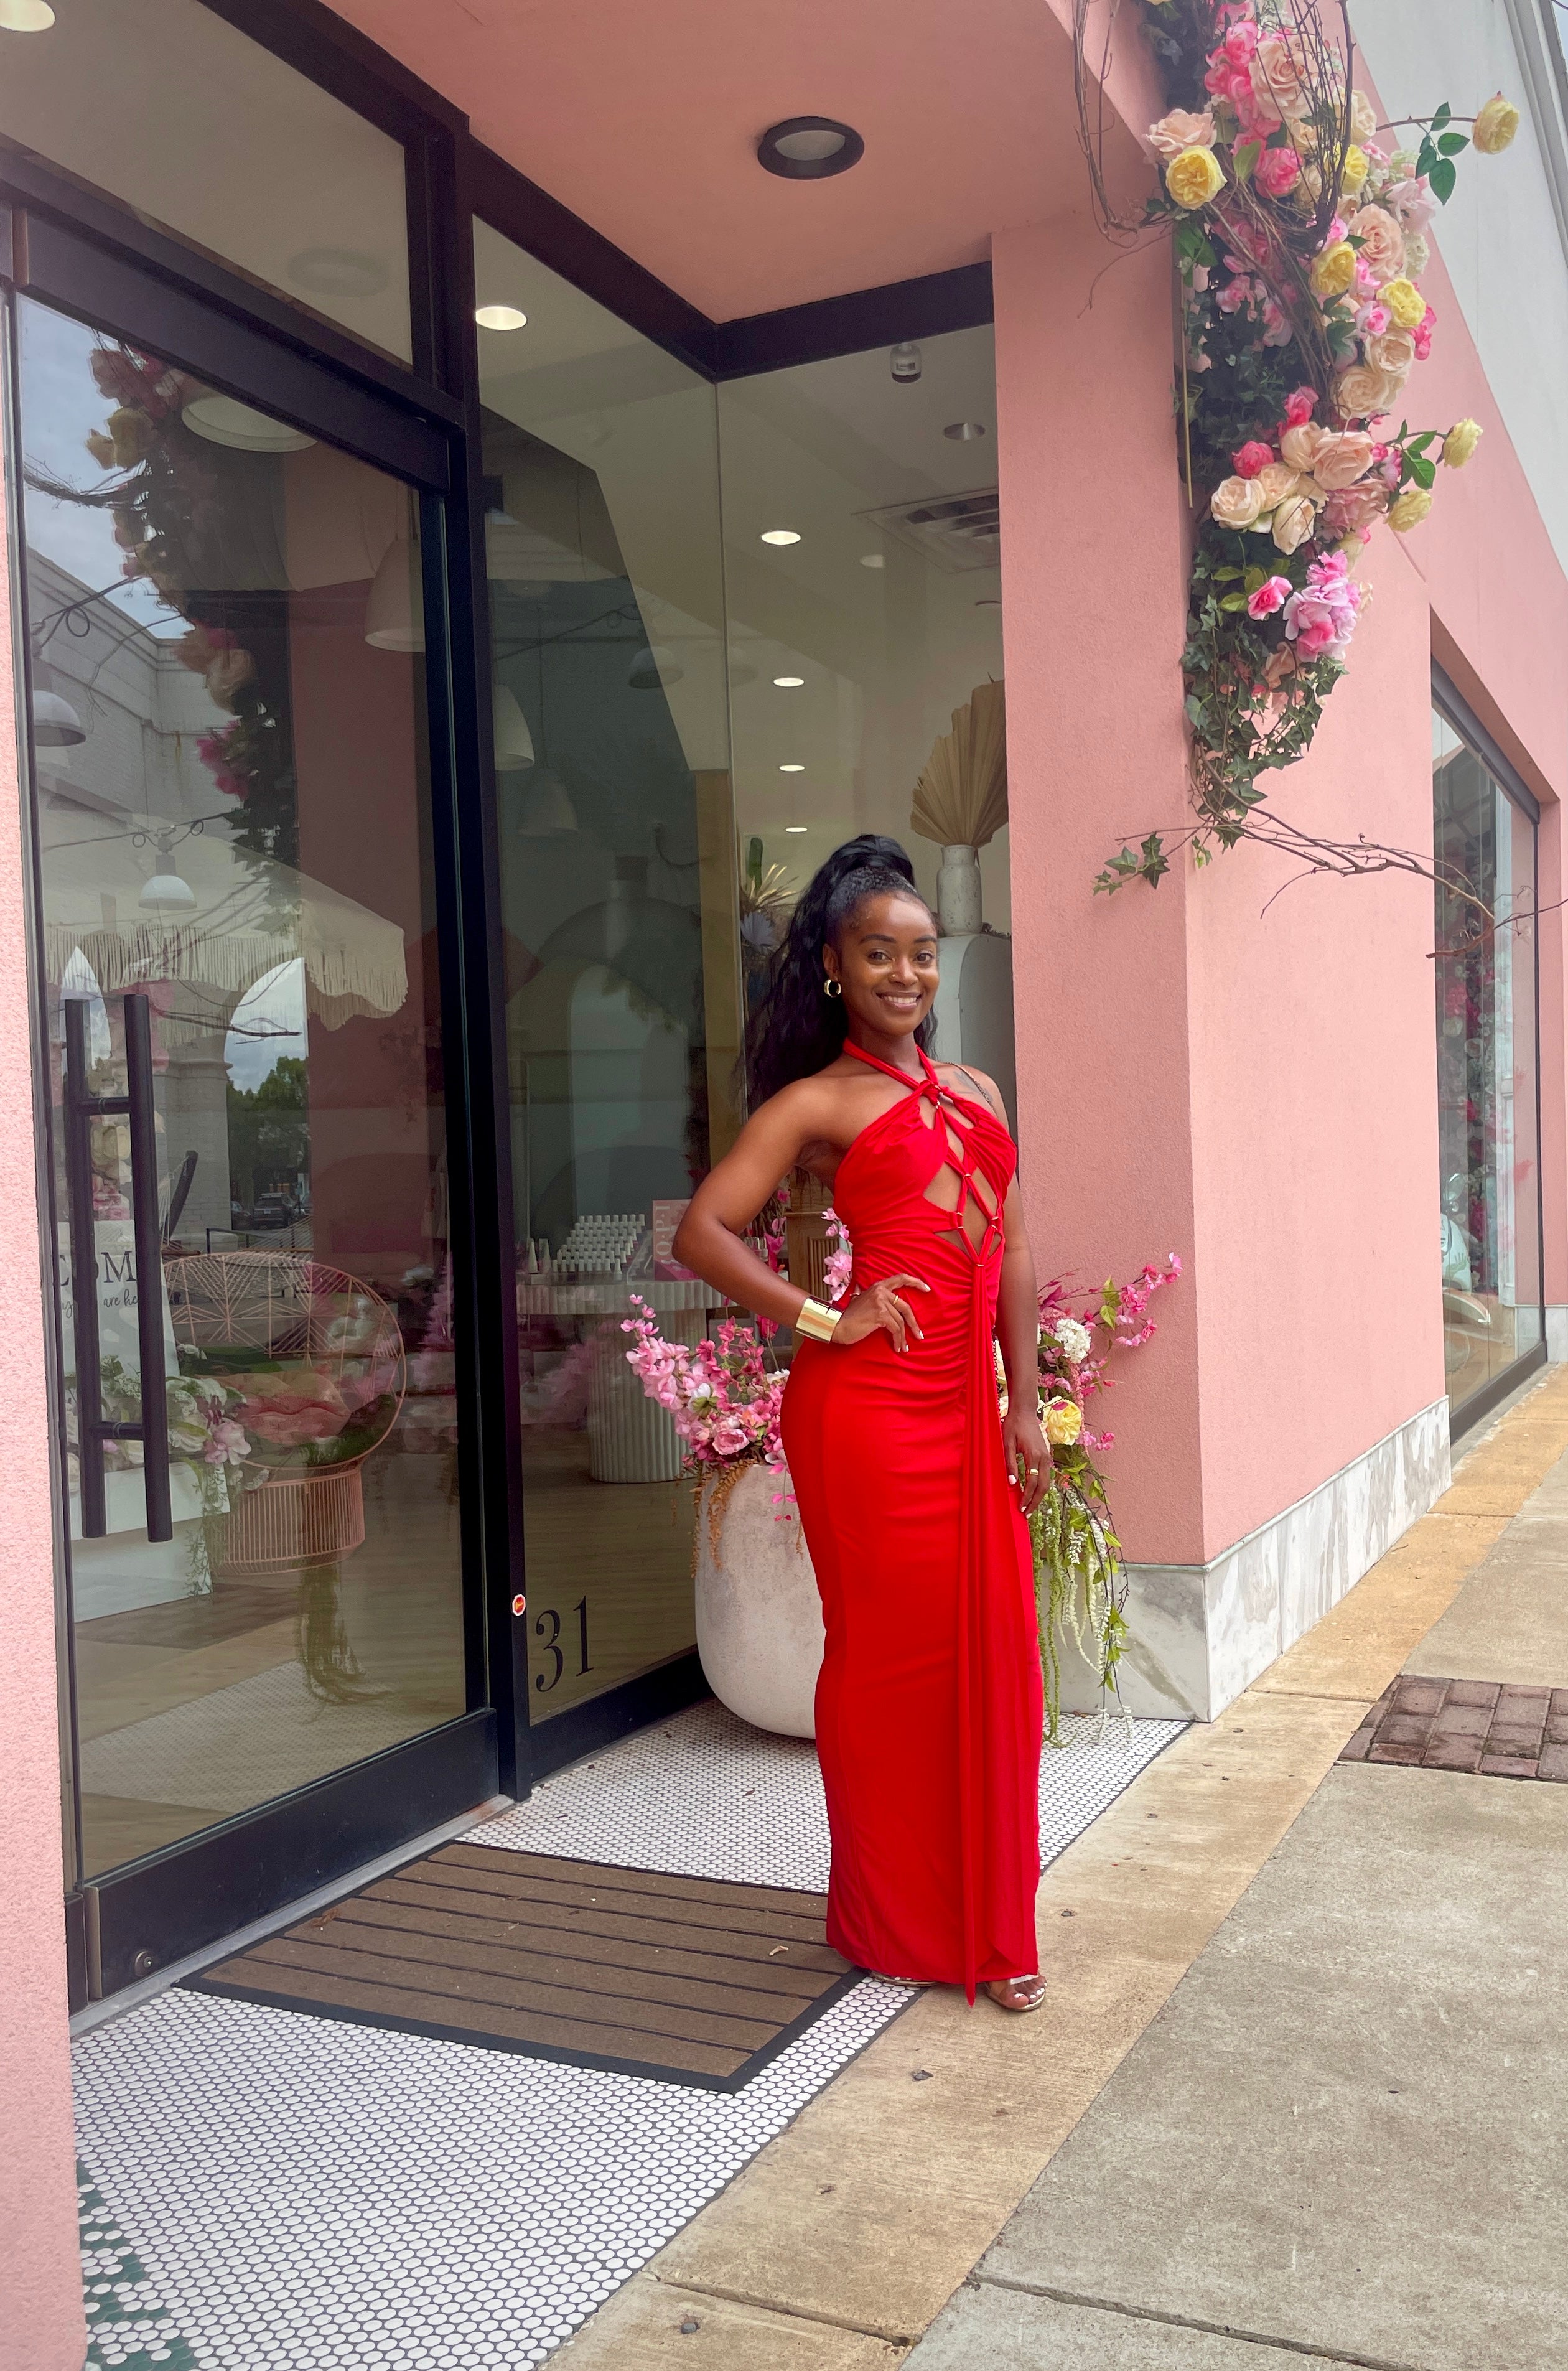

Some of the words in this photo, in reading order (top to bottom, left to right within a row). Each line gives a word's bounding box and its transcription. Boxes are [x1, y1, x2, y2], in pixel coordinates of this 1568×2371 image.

[103, 1296, 121, 1307] are
[124, 1288, 138, 1307] he
[536, 1595, 594, 1693] 31
